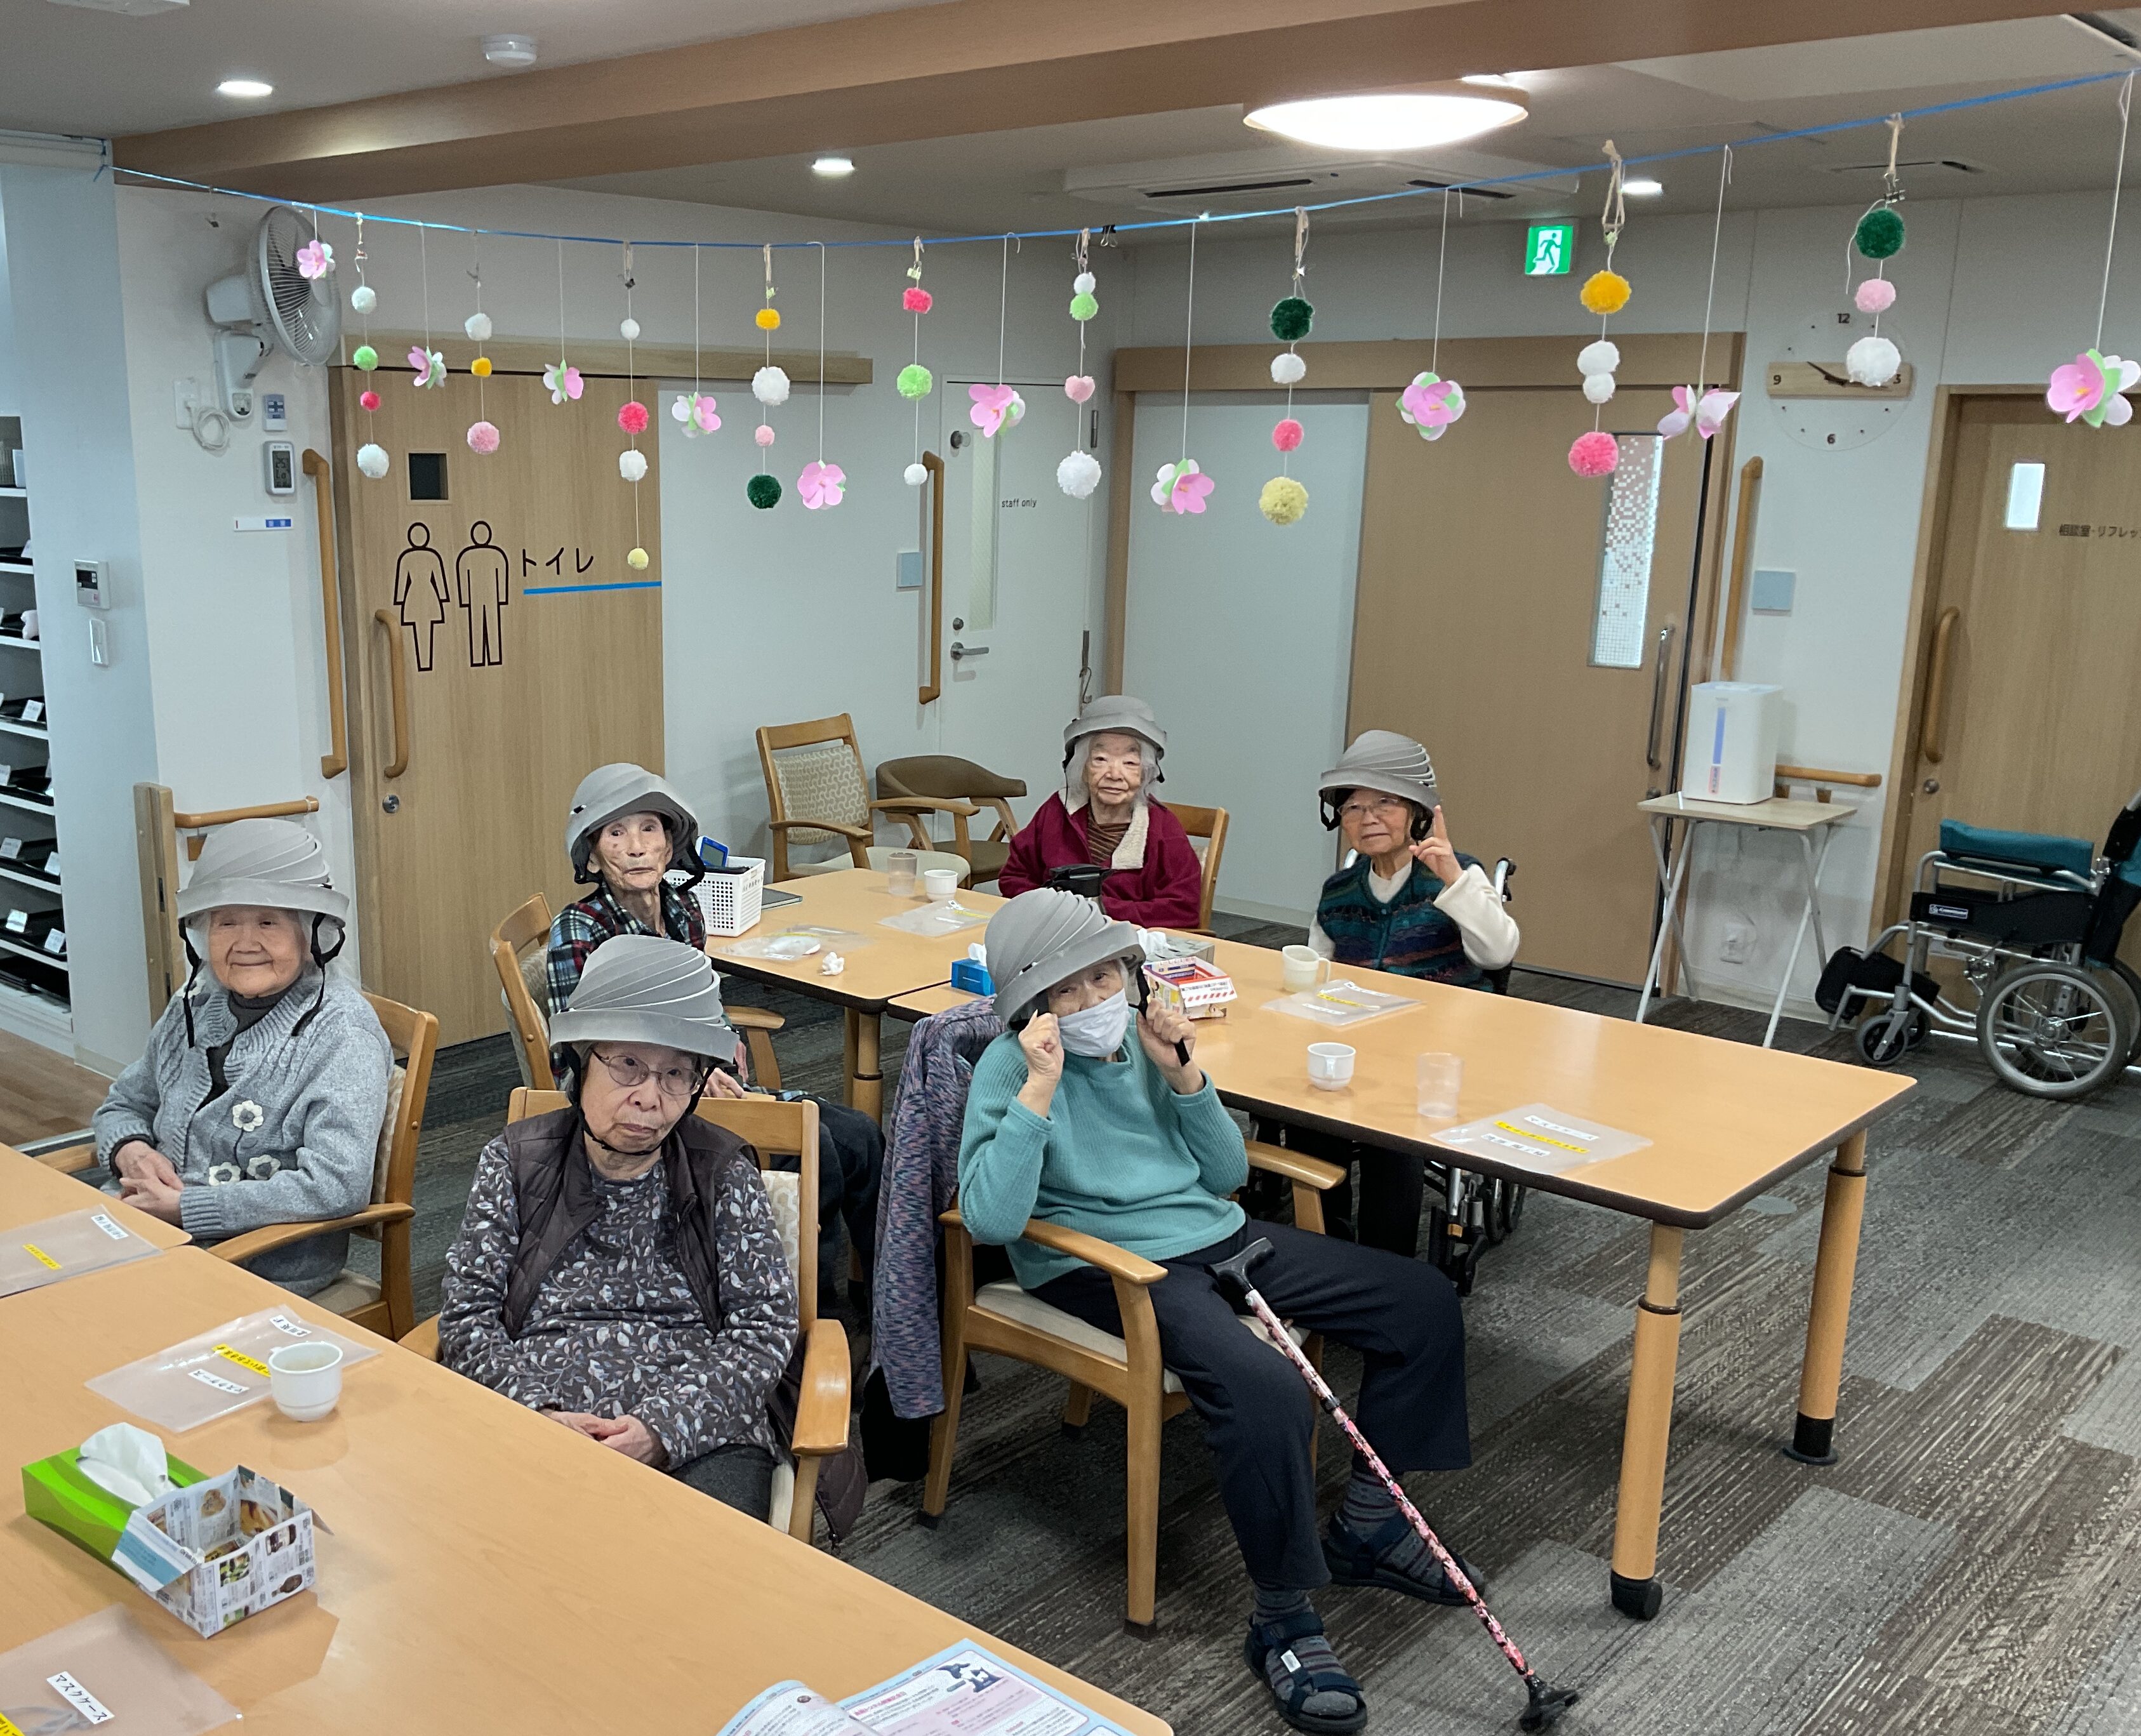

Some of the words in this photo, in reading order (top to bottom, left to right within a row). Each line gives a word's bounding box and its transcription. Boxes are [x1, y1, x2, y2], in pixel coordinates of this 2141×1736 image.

[1837, 313, 1850, 324] 12
[1773, 374, 1782, 385] 9
[1893, 374, 1902, 384] 3
[1827, 434, 1836, 444] 6
[1002, 498, 1019, 508] staff
[1021, 498, 1037, 508] only
[2059, 524, 2141, 538] 相談室・リフレッ
[522, 547, 593, 577] トイレ
[55, 1674, 109, 1721] マスクケース
